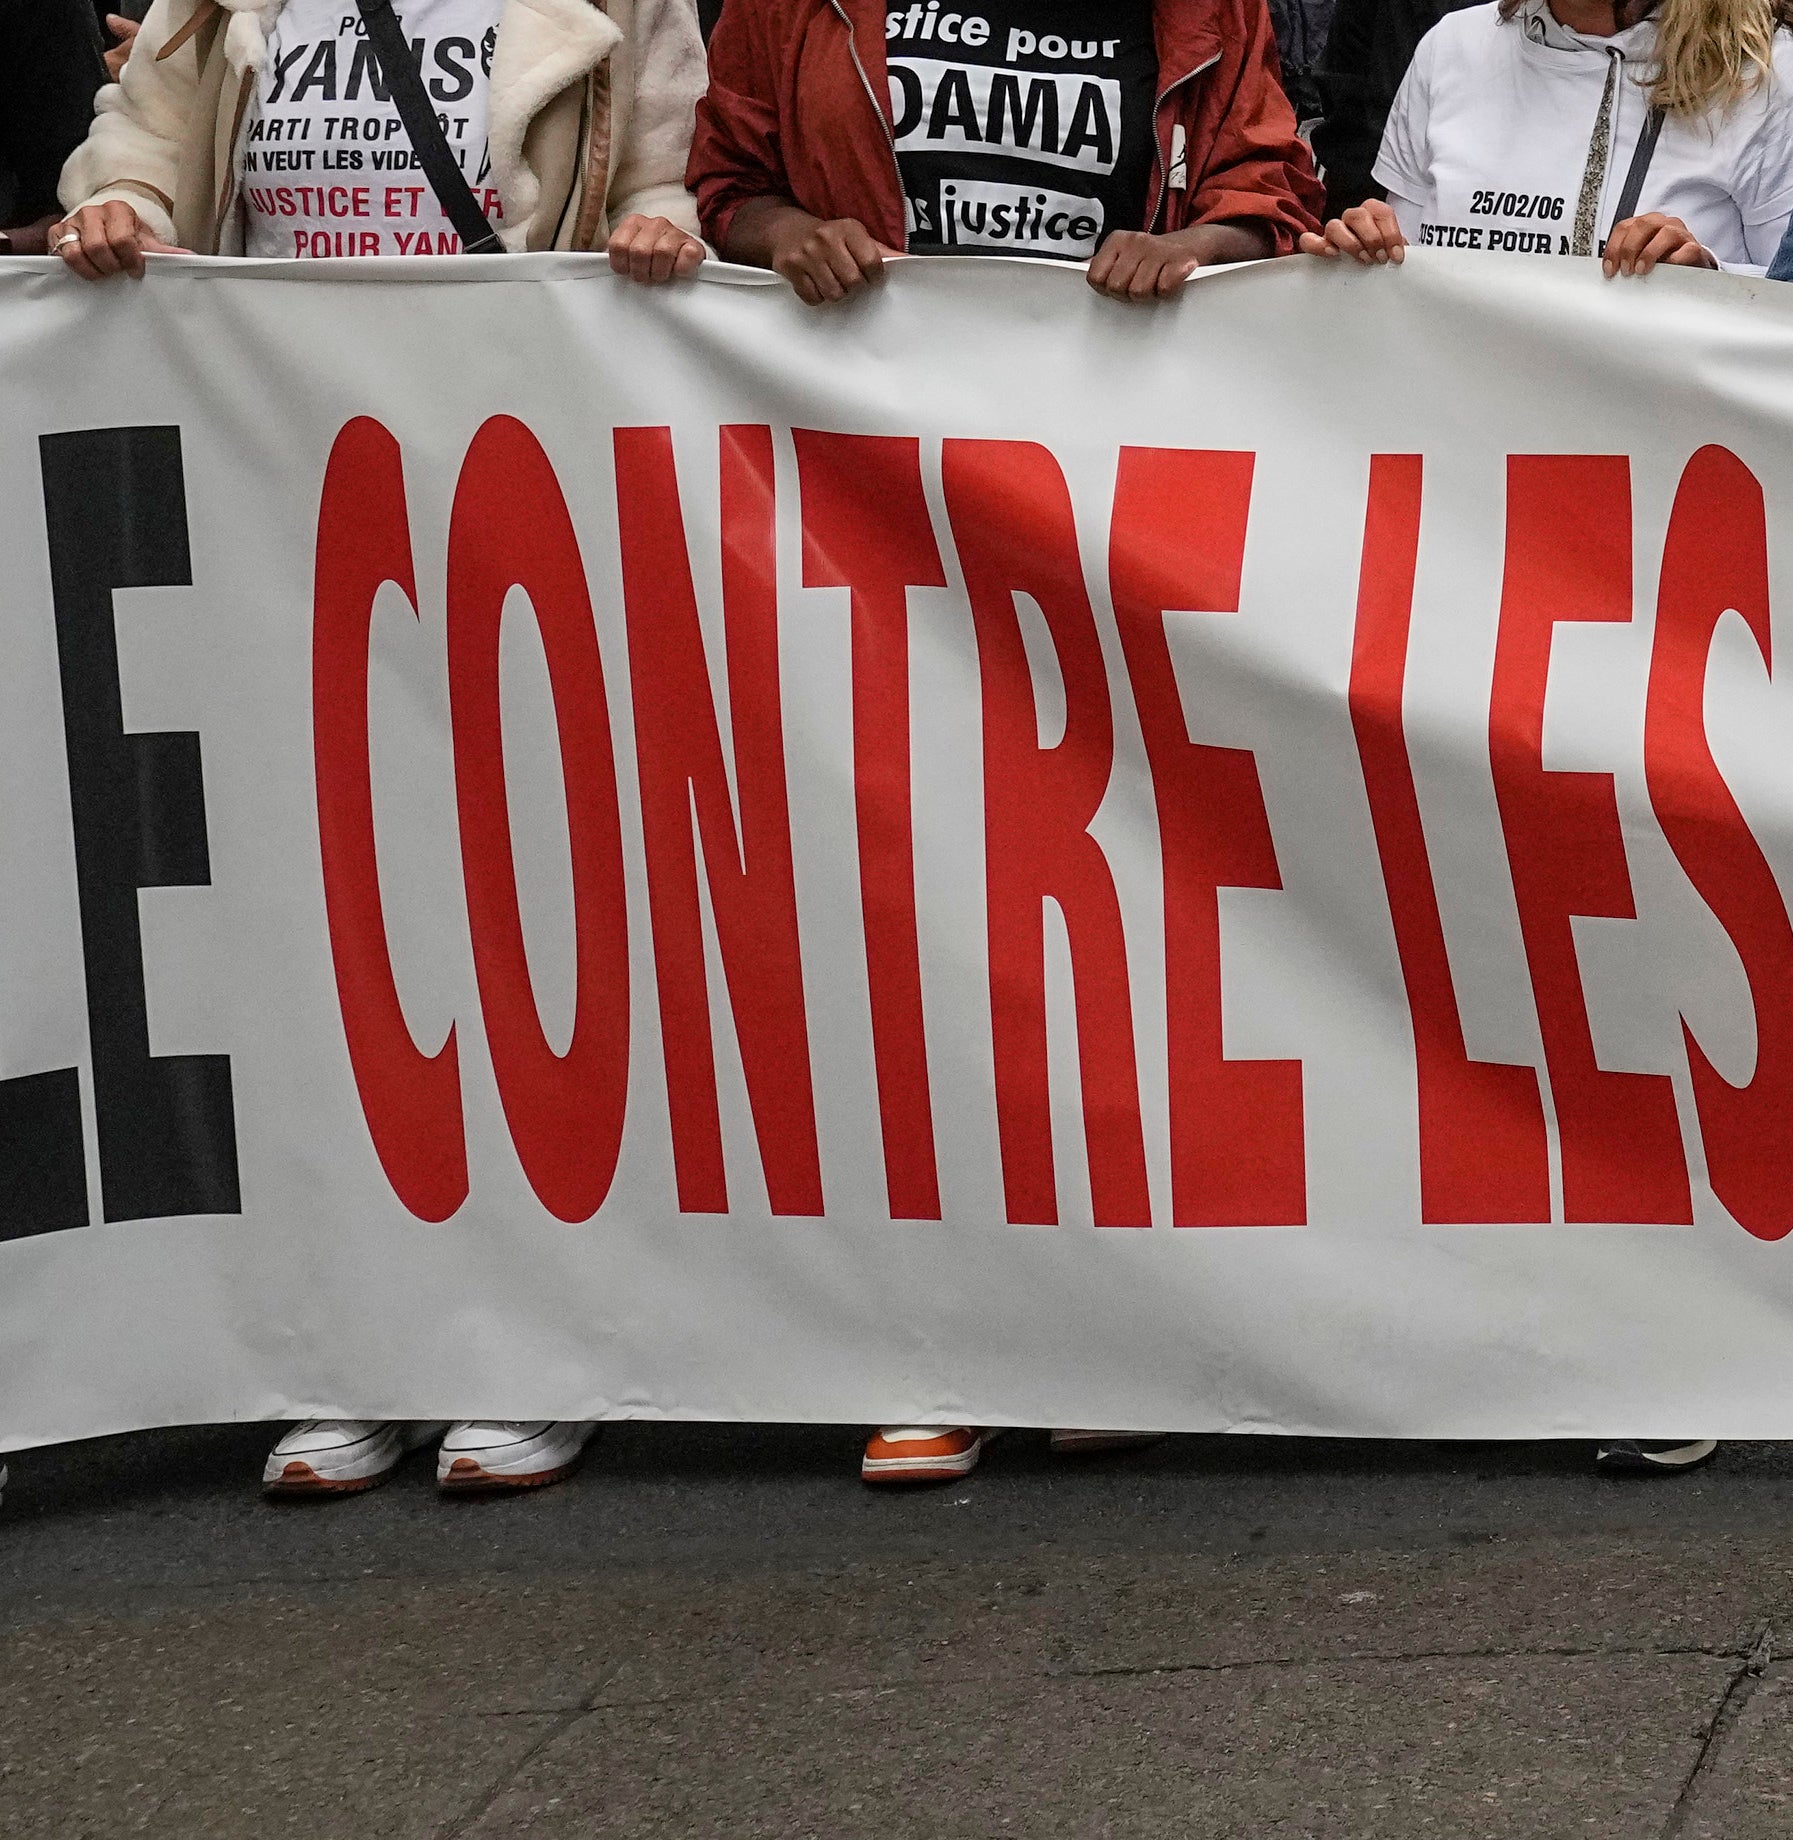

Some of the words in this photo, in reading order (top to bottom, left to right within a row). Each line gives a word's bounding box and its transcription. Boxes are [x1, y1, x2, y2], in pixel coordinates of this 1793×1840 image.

[1005, 27, 1121, 61] pour
[324, 117, 402, 141] TROP
[263, 150, 316, 171] VEUT
[323, 149, 364, 170] LES
[383, 186, 425, 218] ET
[944, 184, 1100, 246] justice
[1470, 190, 1565, 221] 25/02/06
[1488, 229, 1552, 255] POUR
[312, 412, 1307, 1225] CONTRE
